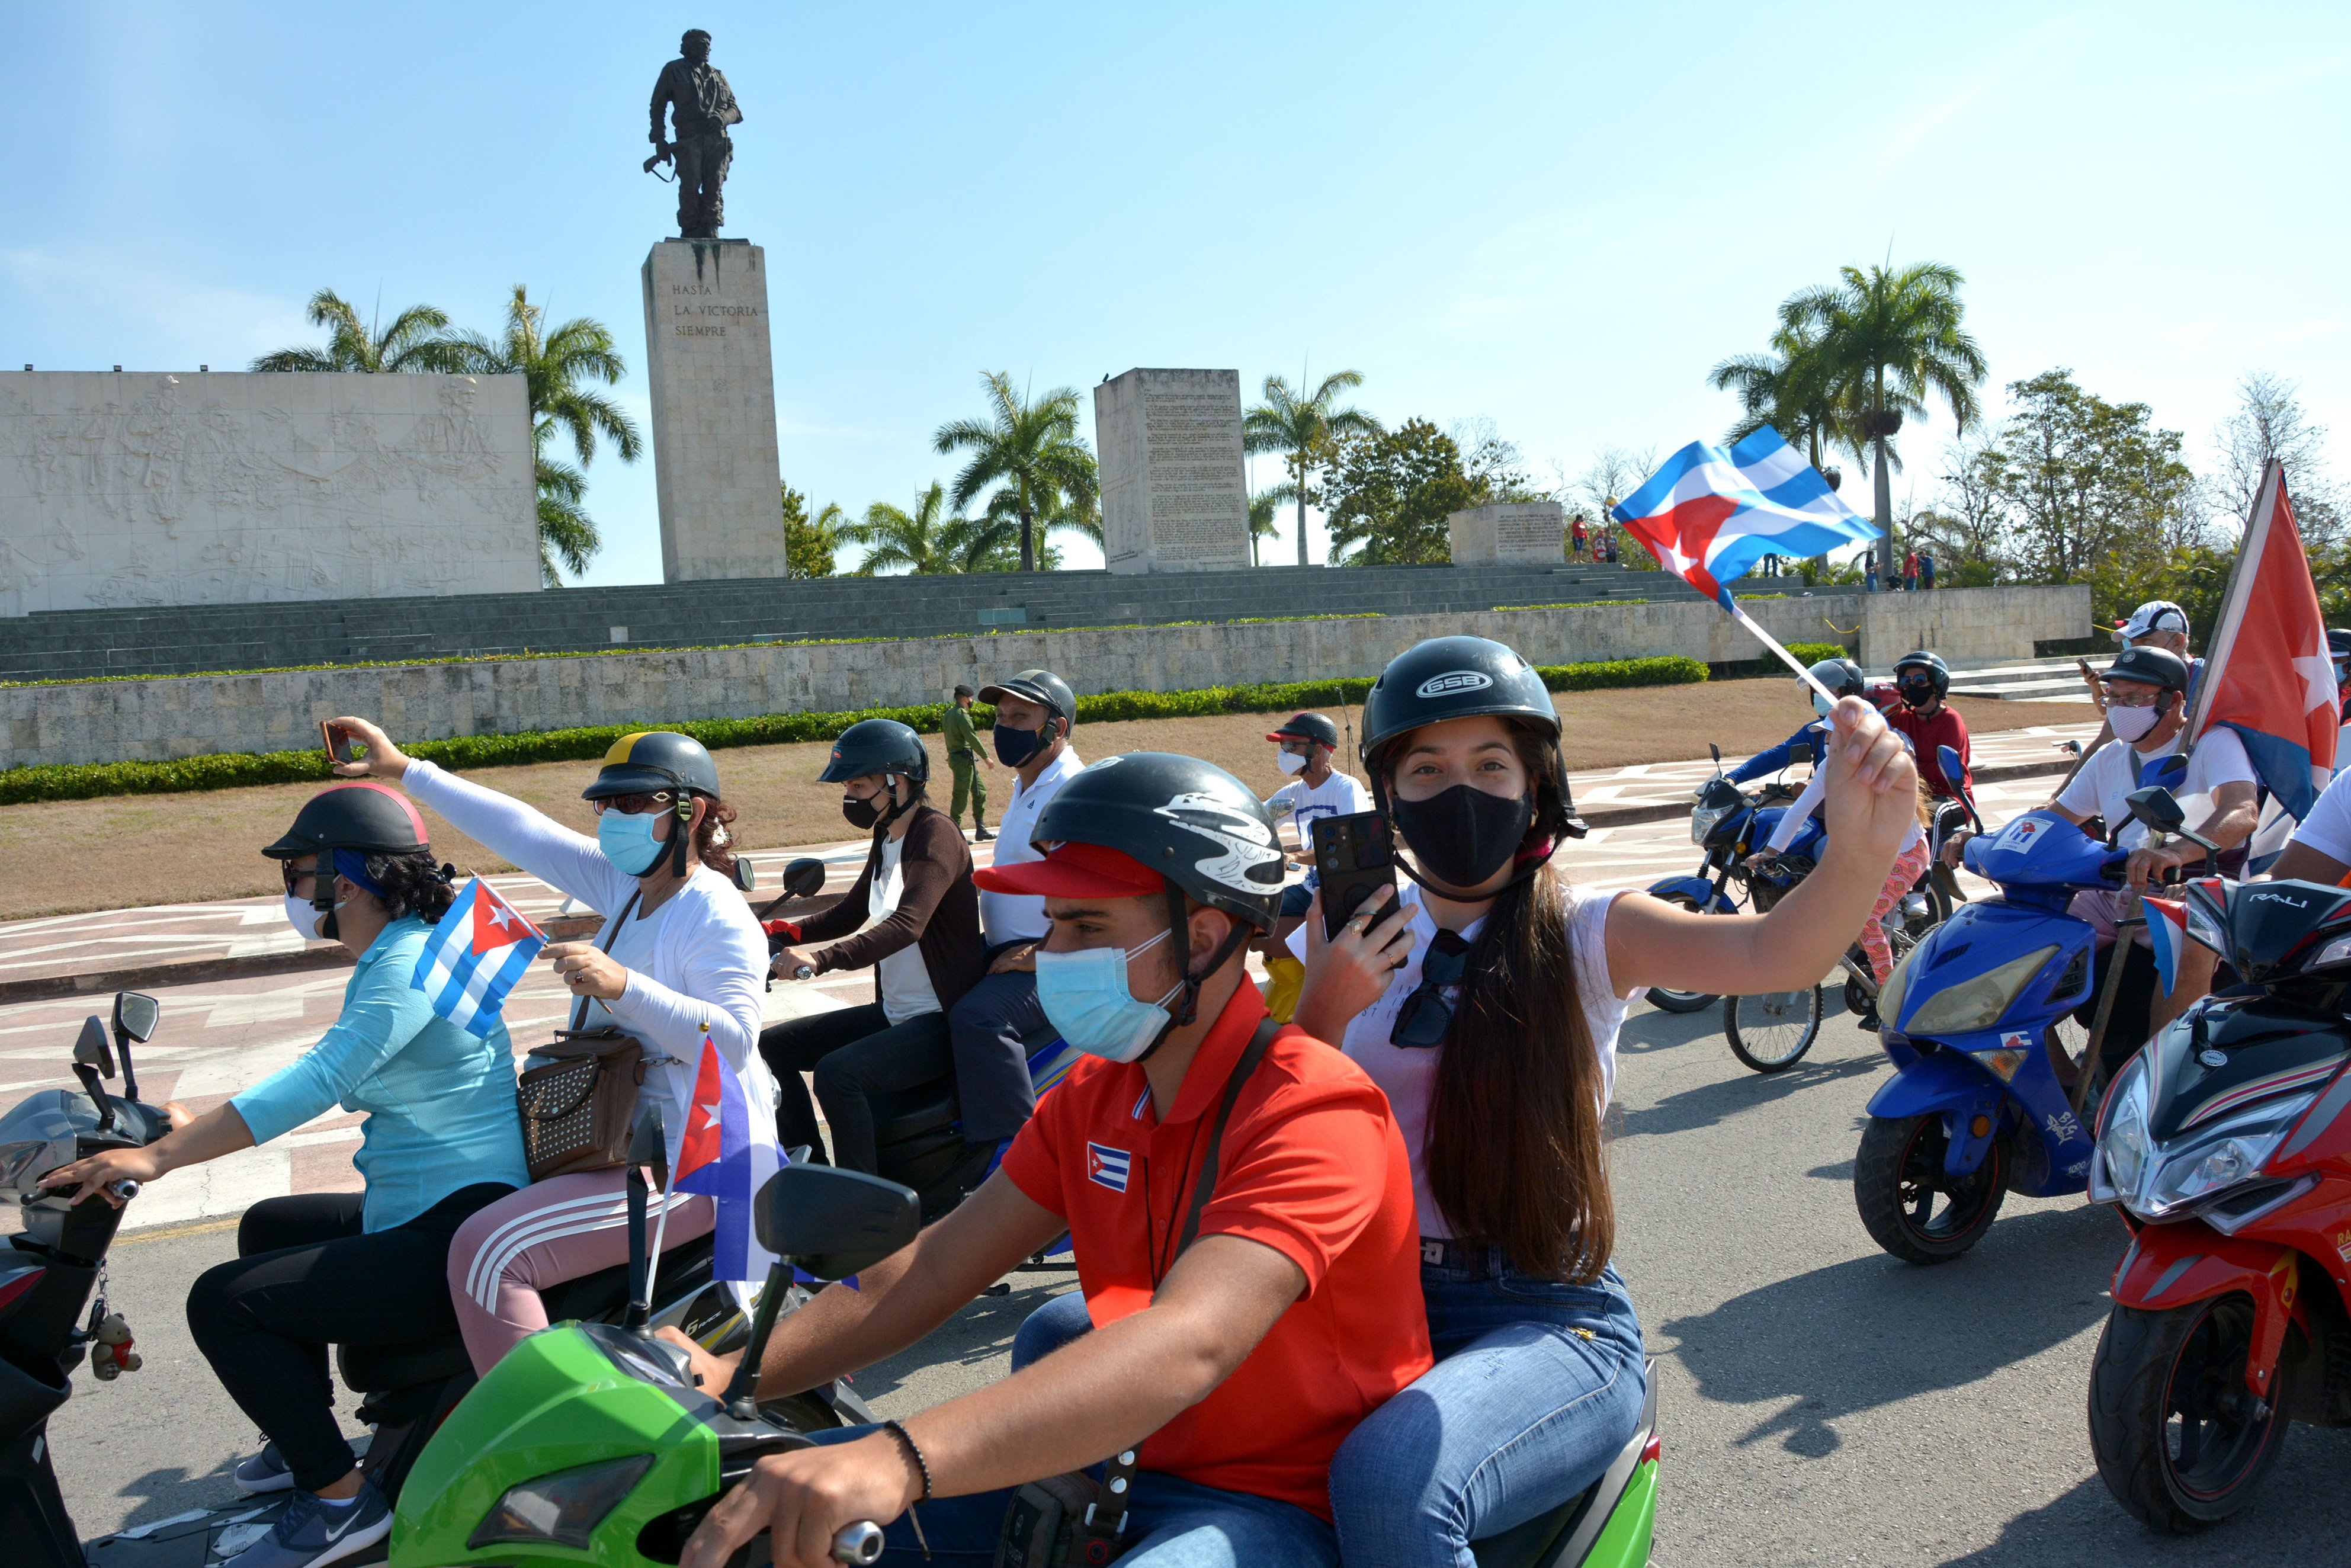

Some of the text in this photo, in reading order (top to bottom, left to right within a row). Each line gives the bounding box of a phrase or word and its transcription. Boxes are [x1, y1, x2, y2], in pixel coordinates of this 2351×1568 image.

[673, 284, 712, 295] HASTA
[675, 305, 758, 316] LA VICTORIA
[675, 326, 726, 336] SIEMPRE
[1426, 675, 1480, 693] GSB
[2249, 894, 2308, 908] RALI
[2058, 1111, 2078, 1136] BIG
[2068, 1160, 2086, 1173] 1000
[698, 1310, 722, 1329] RACE
